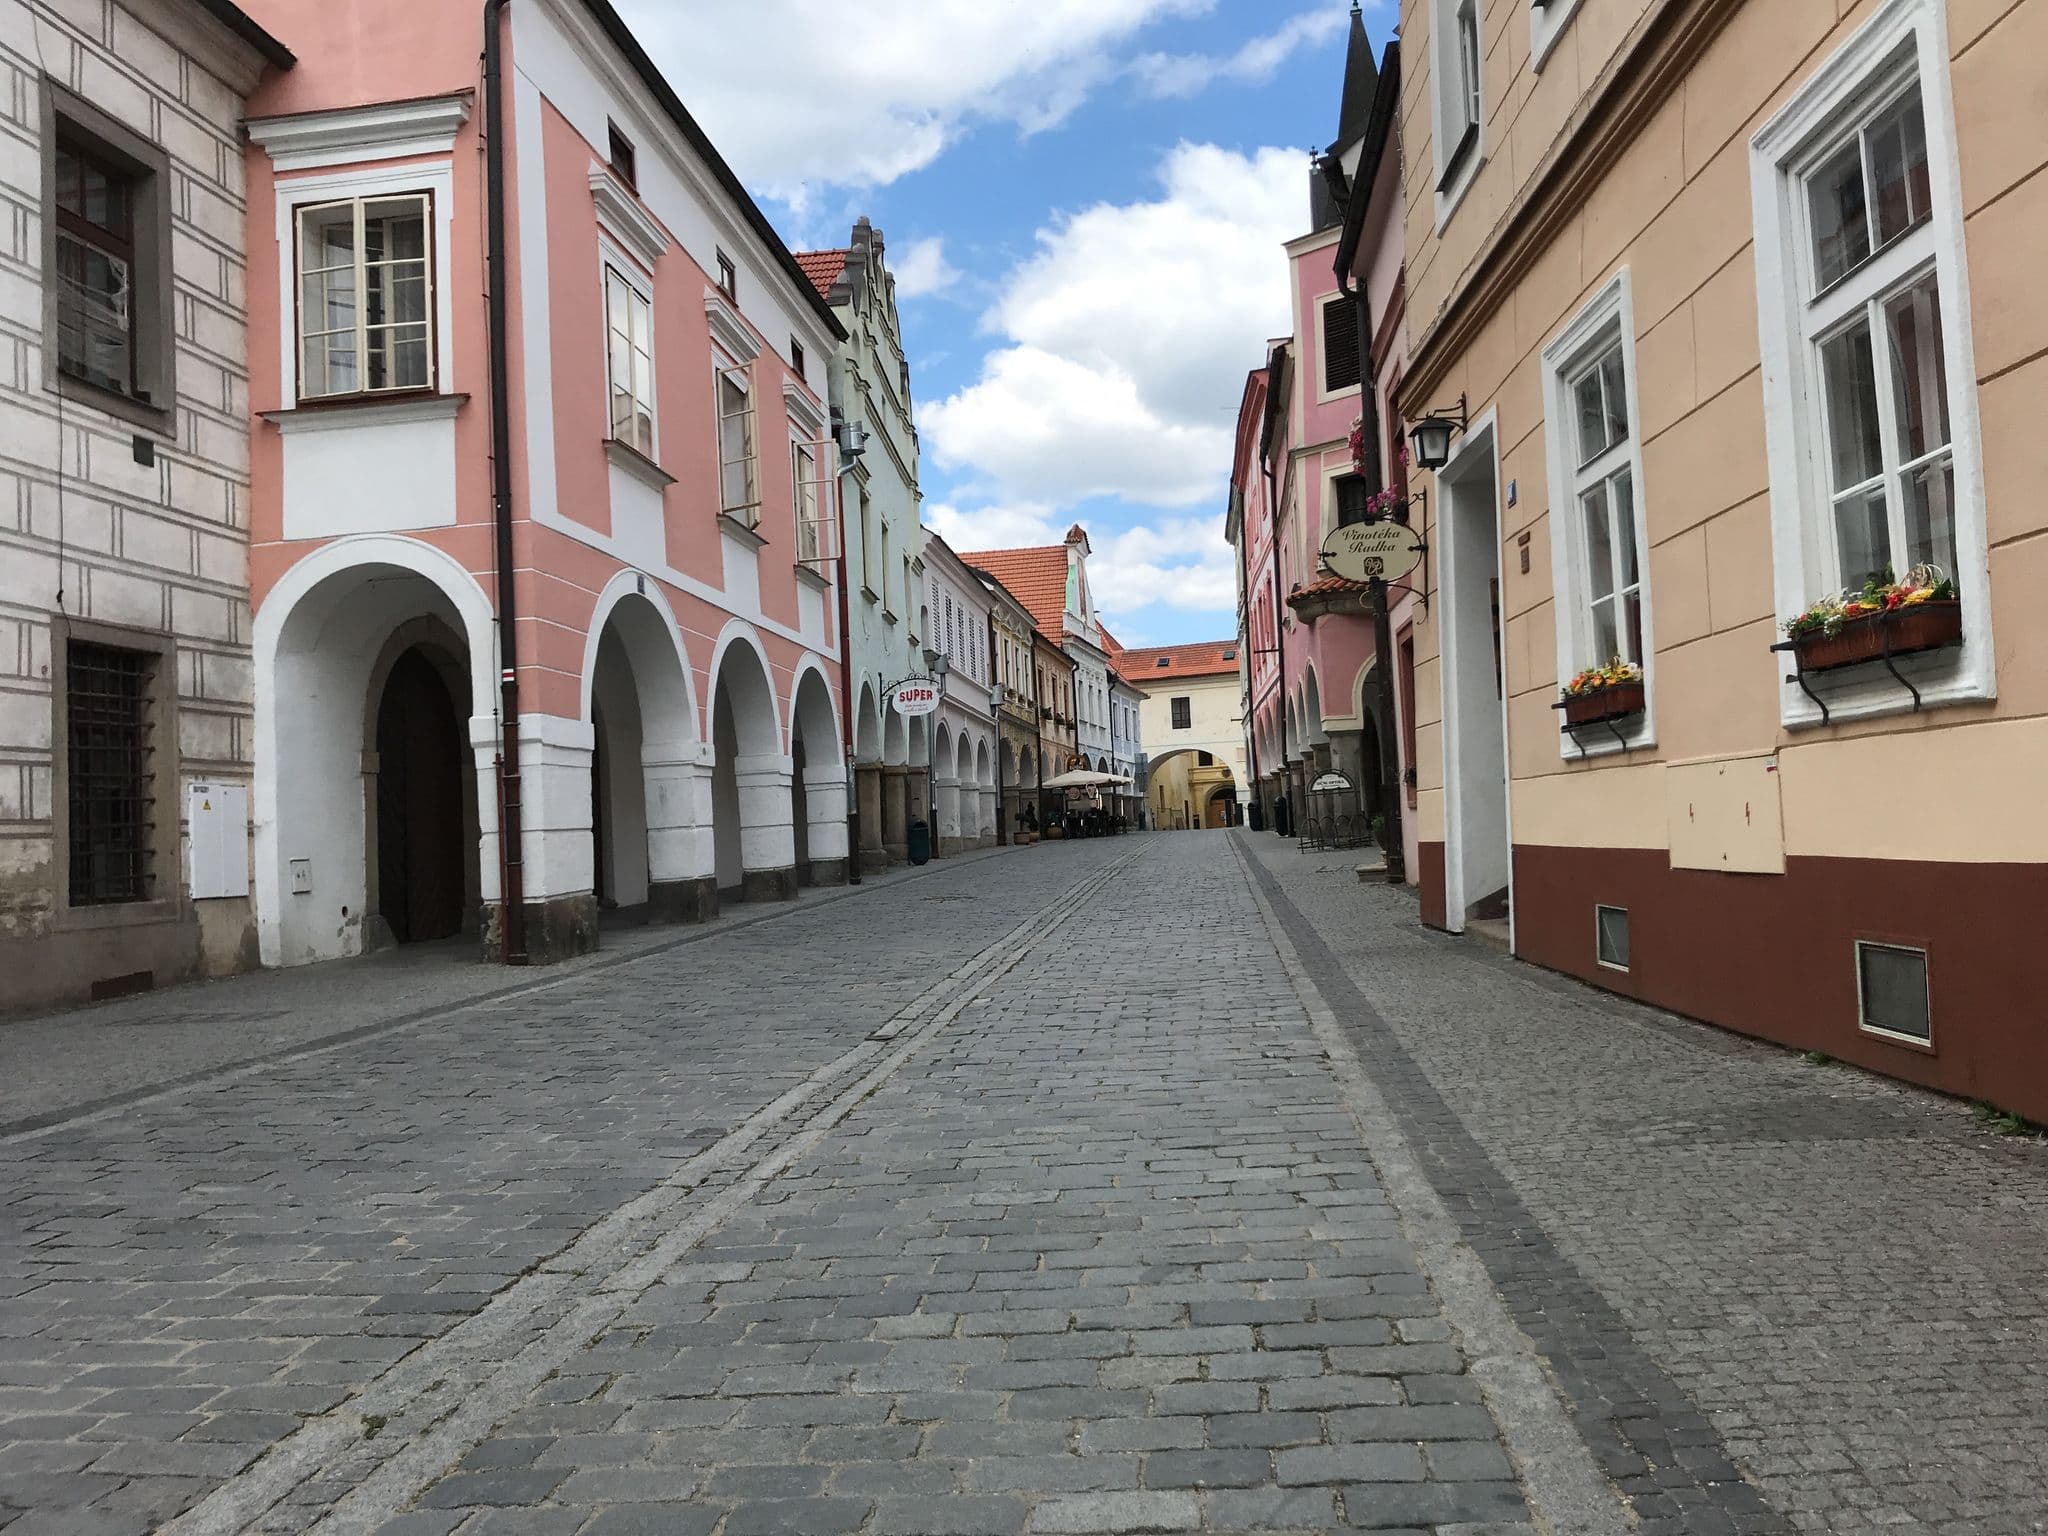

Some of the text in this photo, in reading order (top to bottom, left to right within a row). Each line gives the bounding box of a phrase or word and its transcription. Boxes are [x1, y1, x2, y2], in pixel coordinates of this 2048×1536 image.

[1342, 527, 1400, 541] Vinotéka
[1348, 541, 1396, 553] Radka
[899, 688, 933, 702] SUPER
